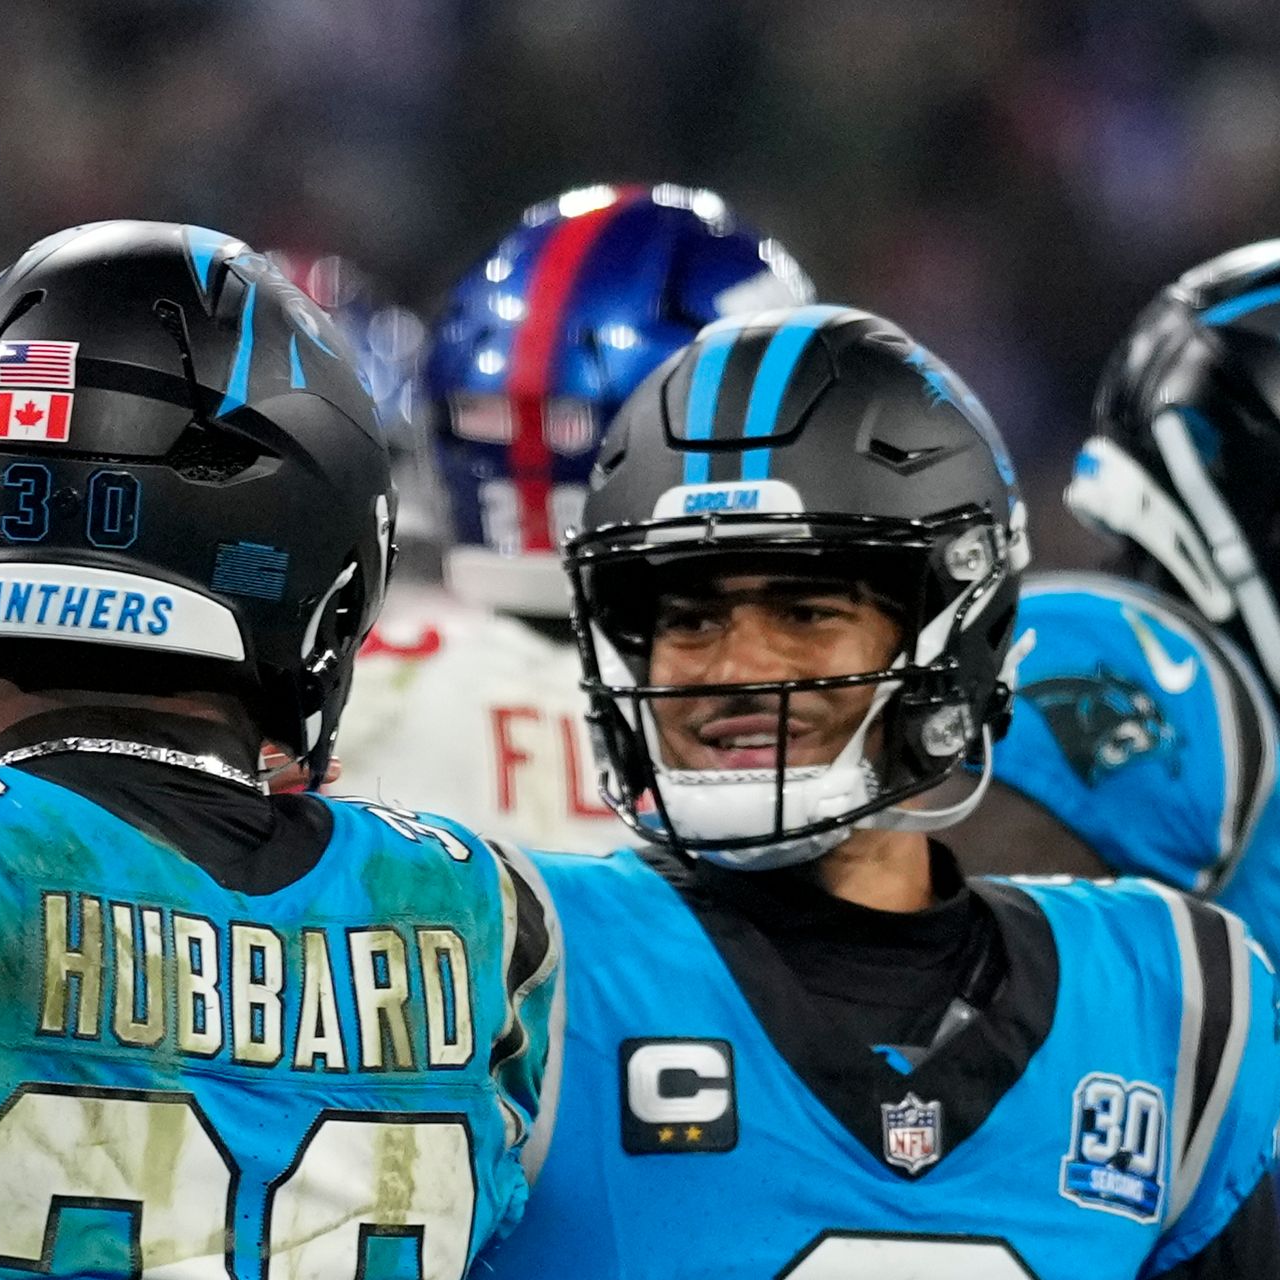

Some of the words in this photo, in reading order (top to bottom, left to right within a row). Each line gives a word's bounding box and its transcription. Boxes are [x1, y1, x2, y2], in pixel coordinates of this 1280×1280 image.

[1, 463, 141, 549] 30
[488, 706, 619, 820] FL
[37, 890, 476, 1073] HUBBARD
[627, 1044, 729, 1124] C
[1081, 1076, 1160, 1178] 30
